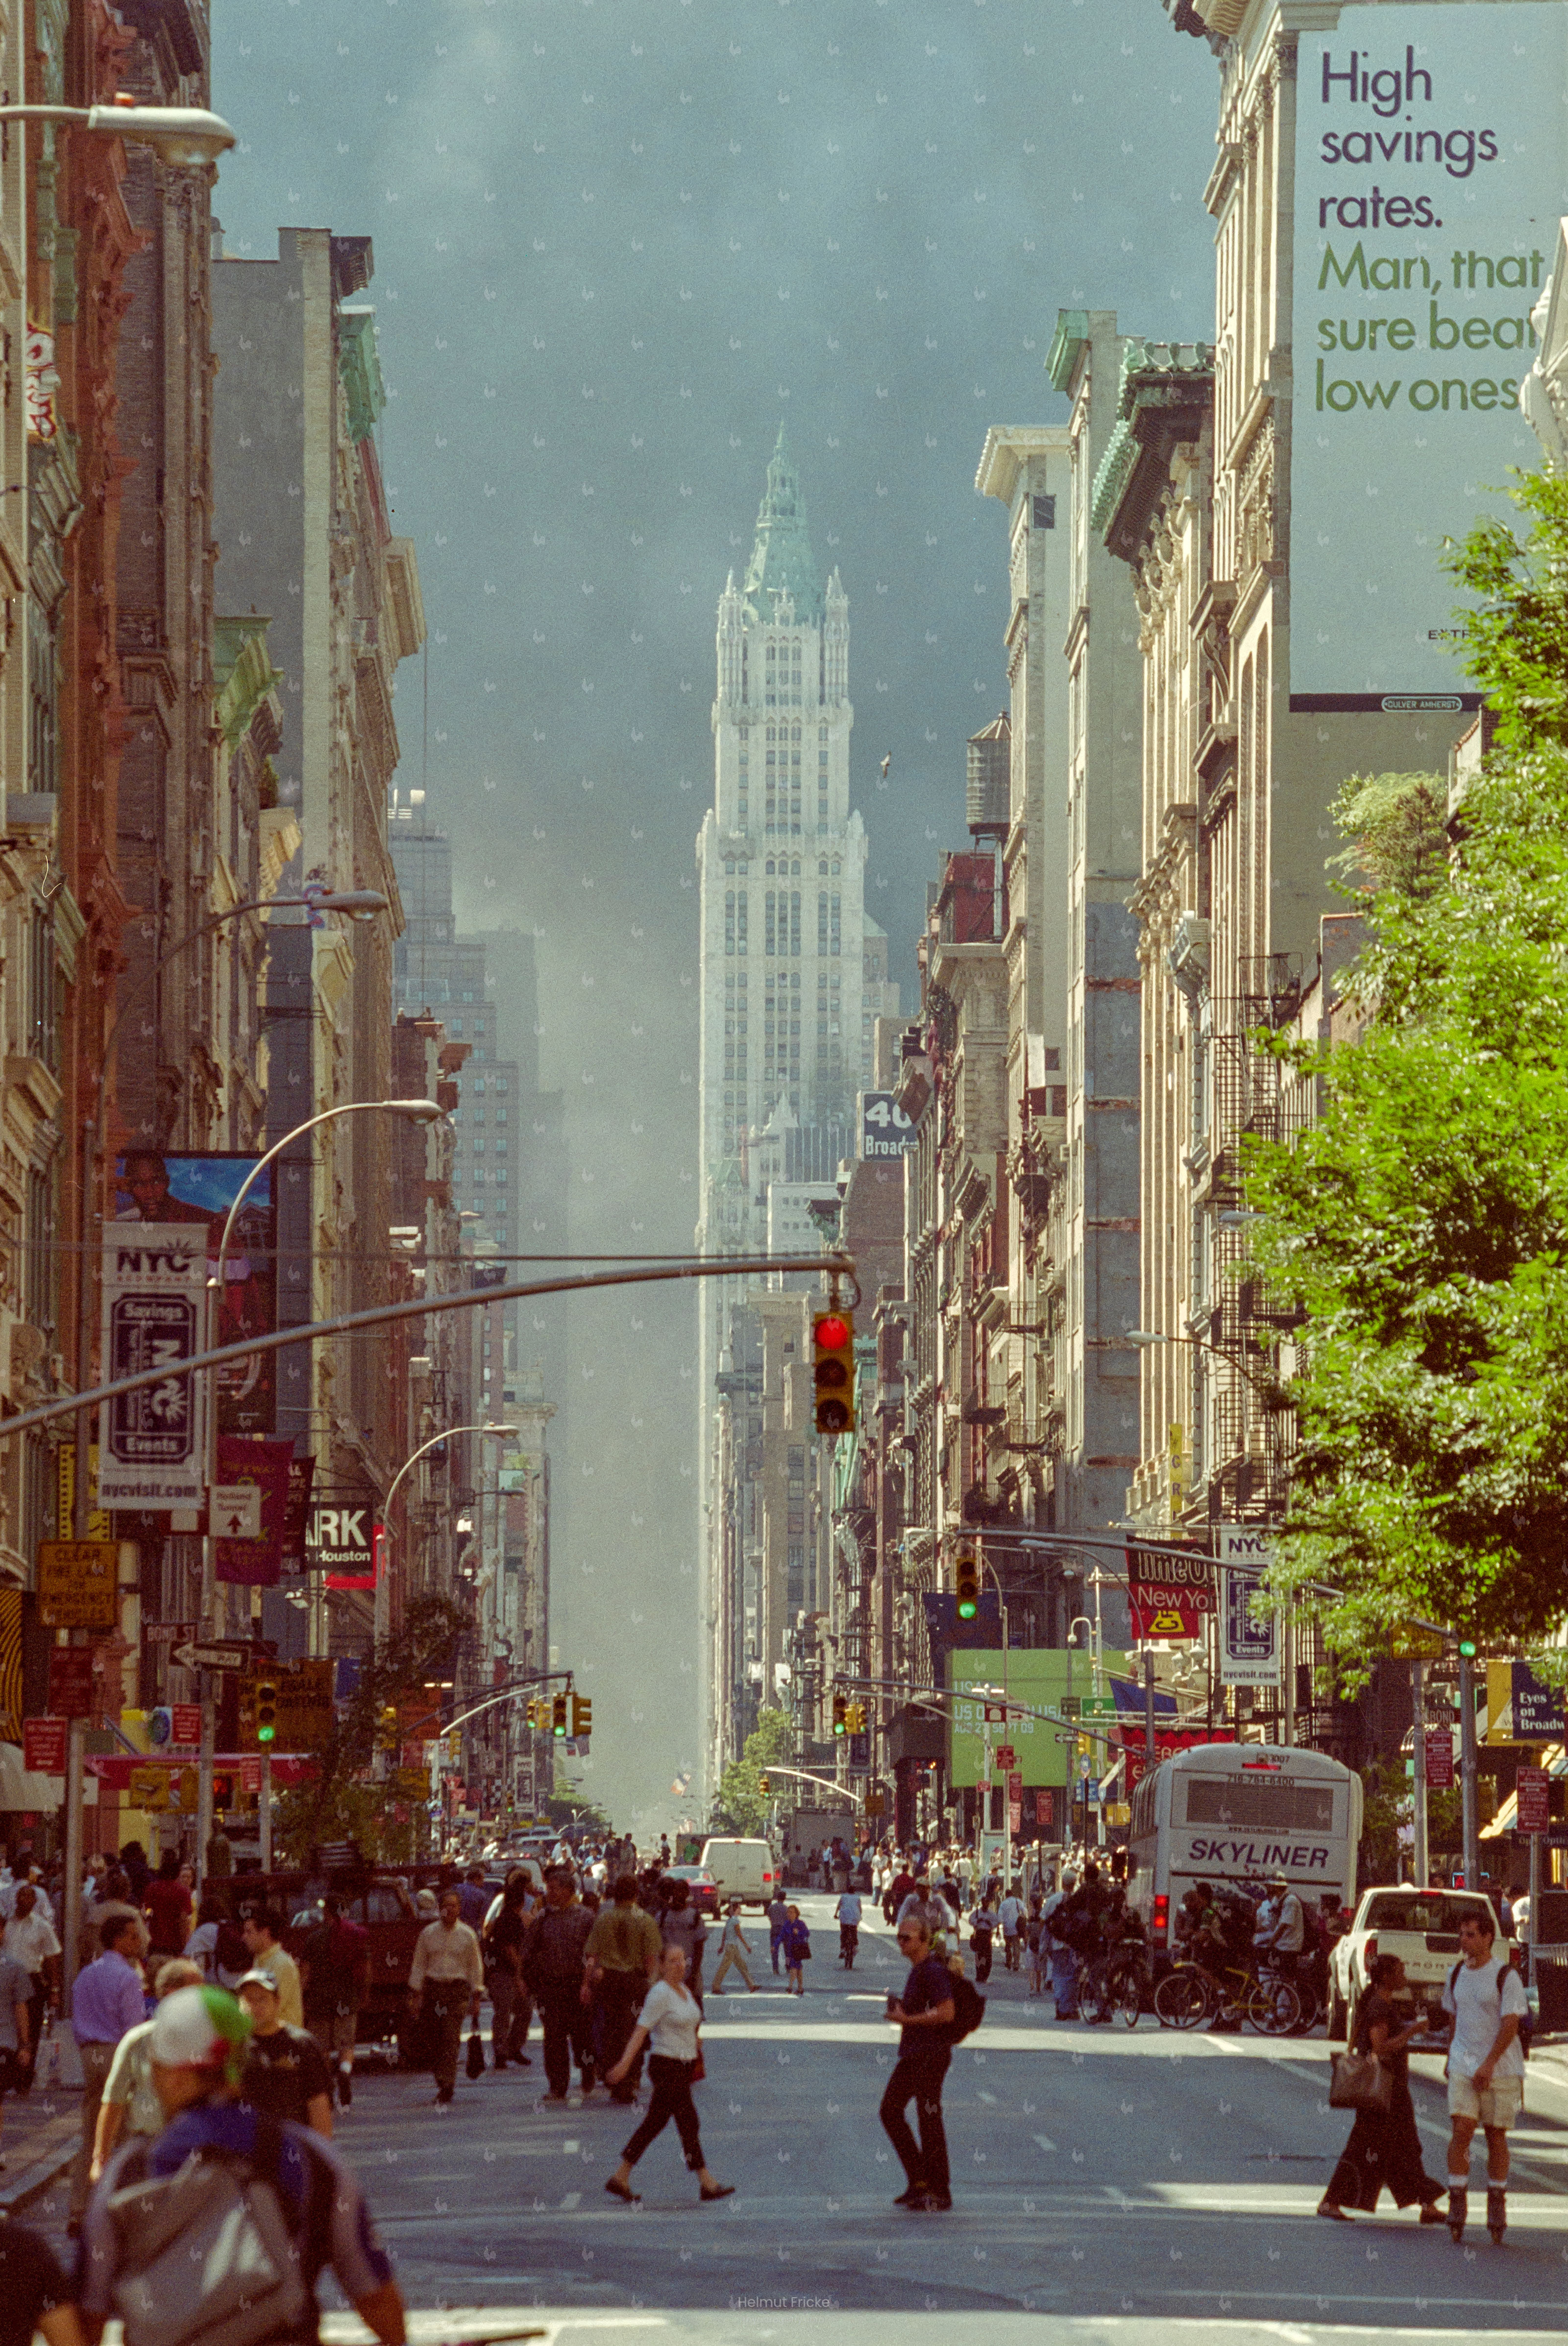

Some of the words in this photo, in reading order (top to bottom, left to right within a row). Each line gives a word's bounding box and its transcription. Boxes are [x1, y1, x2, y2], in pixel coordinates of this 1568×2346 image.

[1321, 46, 1432, 117] High
[1321, 116, 1498, 178] savings
[1319, 186, 1443, 229] rates.
[1318, 241, 1442, 295] Man,
[1451, 250, 1544, 288] that
[1317, 316, 1415, 351] sure
[1316, 358, 1401, 413] low
[118, 1246, 191, 1273] NYC
[1229, 1538, 1268, 1552] NYC
[316, 1550, 371, 1562] Houston
[1138, 1586, 1183, 1607] New
[1236, 1645, 1265, 1654] Events
[1224, 1670, 1276, 1679] nycvisit.com
[1520, 1692, 1547, 1705] Eyes
[954, 1705, 972, 1720] US
[1430, 1710, 1455, 1723] BOND
[1520, 1708, 1536, 1717] on
[1189, 1839, 1329, 1868] SKYLINER
